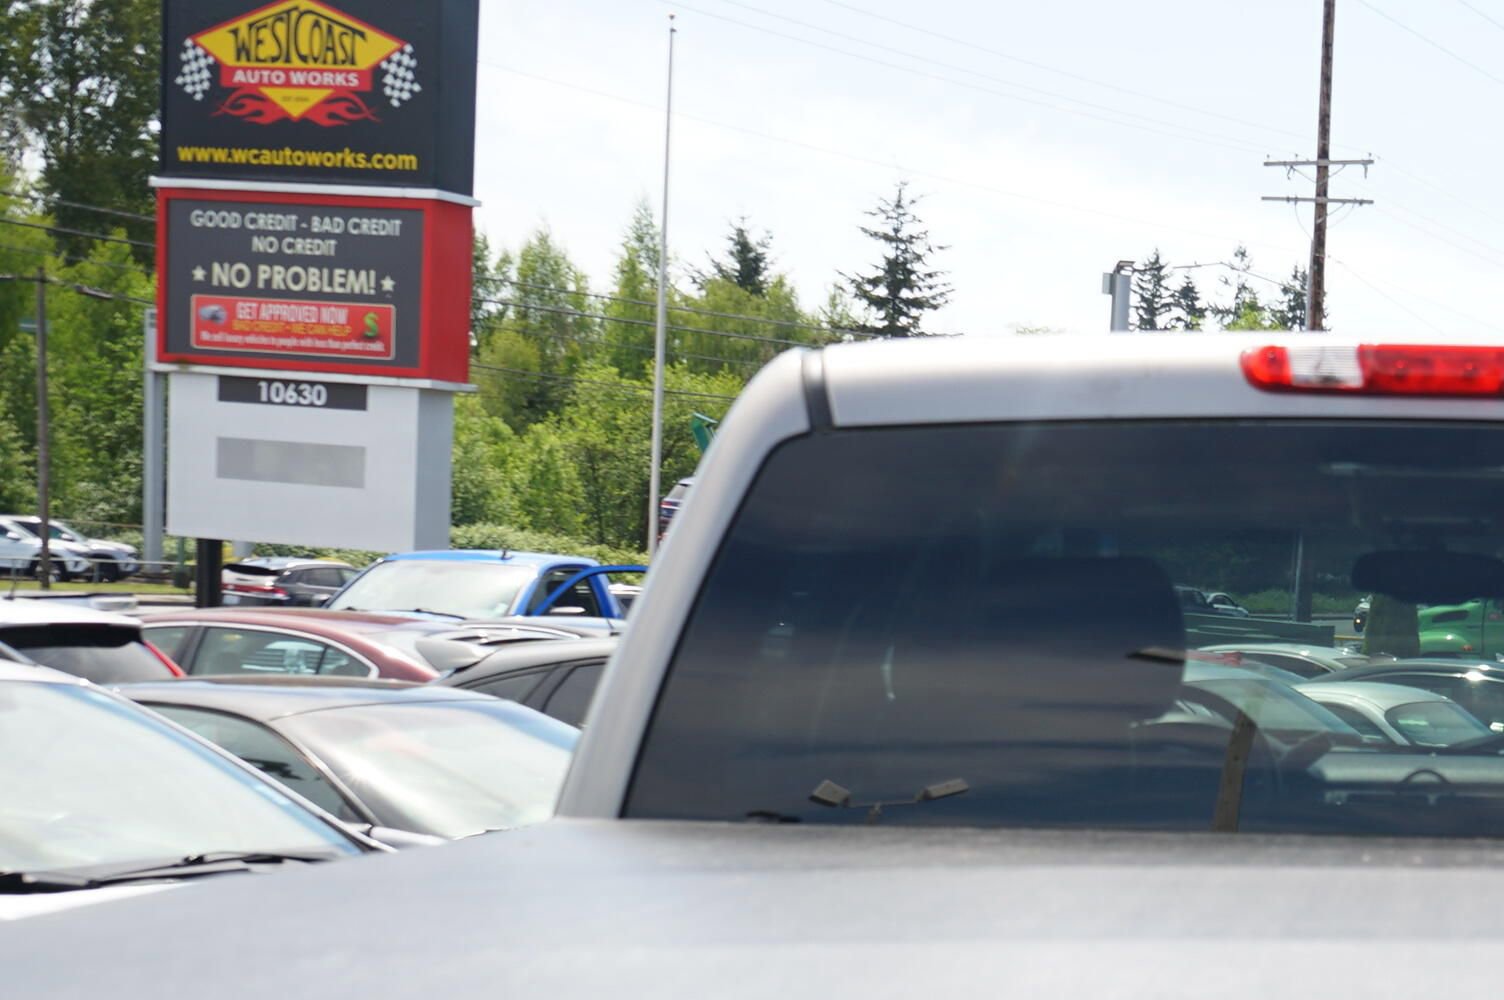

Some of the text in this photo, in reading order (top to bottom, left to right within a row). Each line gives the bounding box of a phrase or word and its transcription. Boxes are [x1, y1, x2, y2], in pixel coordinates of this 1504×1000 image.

[233, 69, 360, 88] AUTO WORKS
[177, 144, 418, 171] www.wcautoworks.com
[190, 209, 242, 229] GOOD
[244, 212, 298, 232] CREDIT
[311, 215, 345, 235] BAD
[347, 217, 402, 237] CREDIT
[251, 235, 338, 257] NO CREDIT
[211, 261, 377, 296] NO PROBLEM!
[259, 303, 319, 324] APPROVED
[258, 380, 328, 406] 10630
